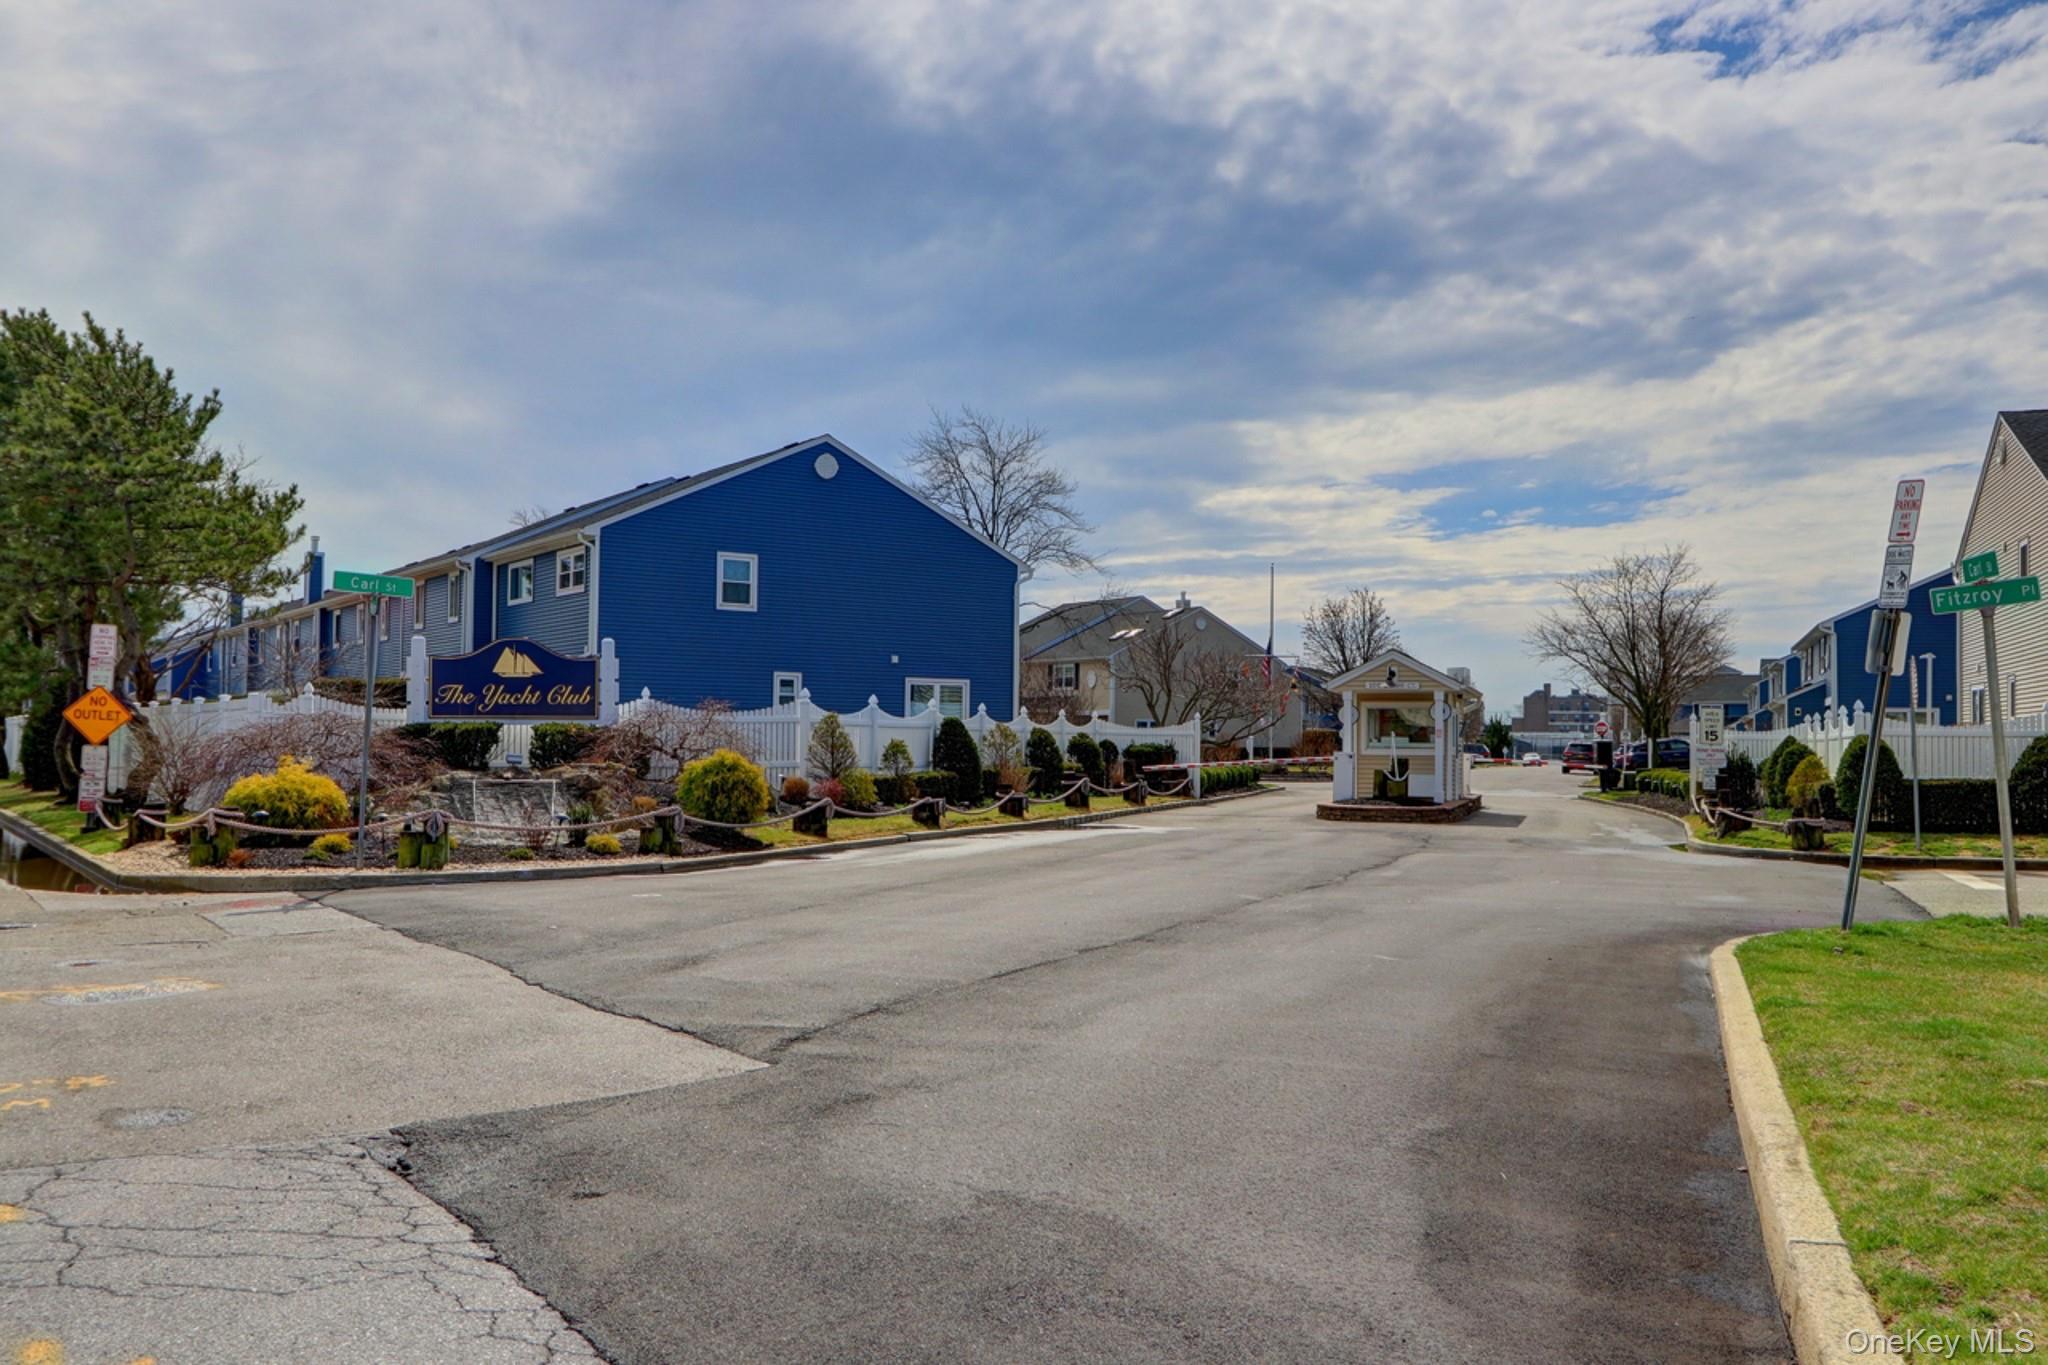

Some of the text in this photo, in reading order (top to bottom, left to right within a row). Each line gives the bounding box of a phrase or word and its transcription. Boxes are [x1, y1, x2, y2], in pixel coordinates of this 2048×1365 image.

[1904, 486, 1916, 497] NO
[1896, 499, 1920, 511] PARKING
[351, 576, 397, 593] Carl St
[1935, 584, 2037, 608] Fitzroy Pl
[89, 696, 108, 707] NO
[434, 683, 593, 713] The Yacht Club
[73, 708, 121, 721] OUTLET
[1705, 730, 1719, 742] 15
